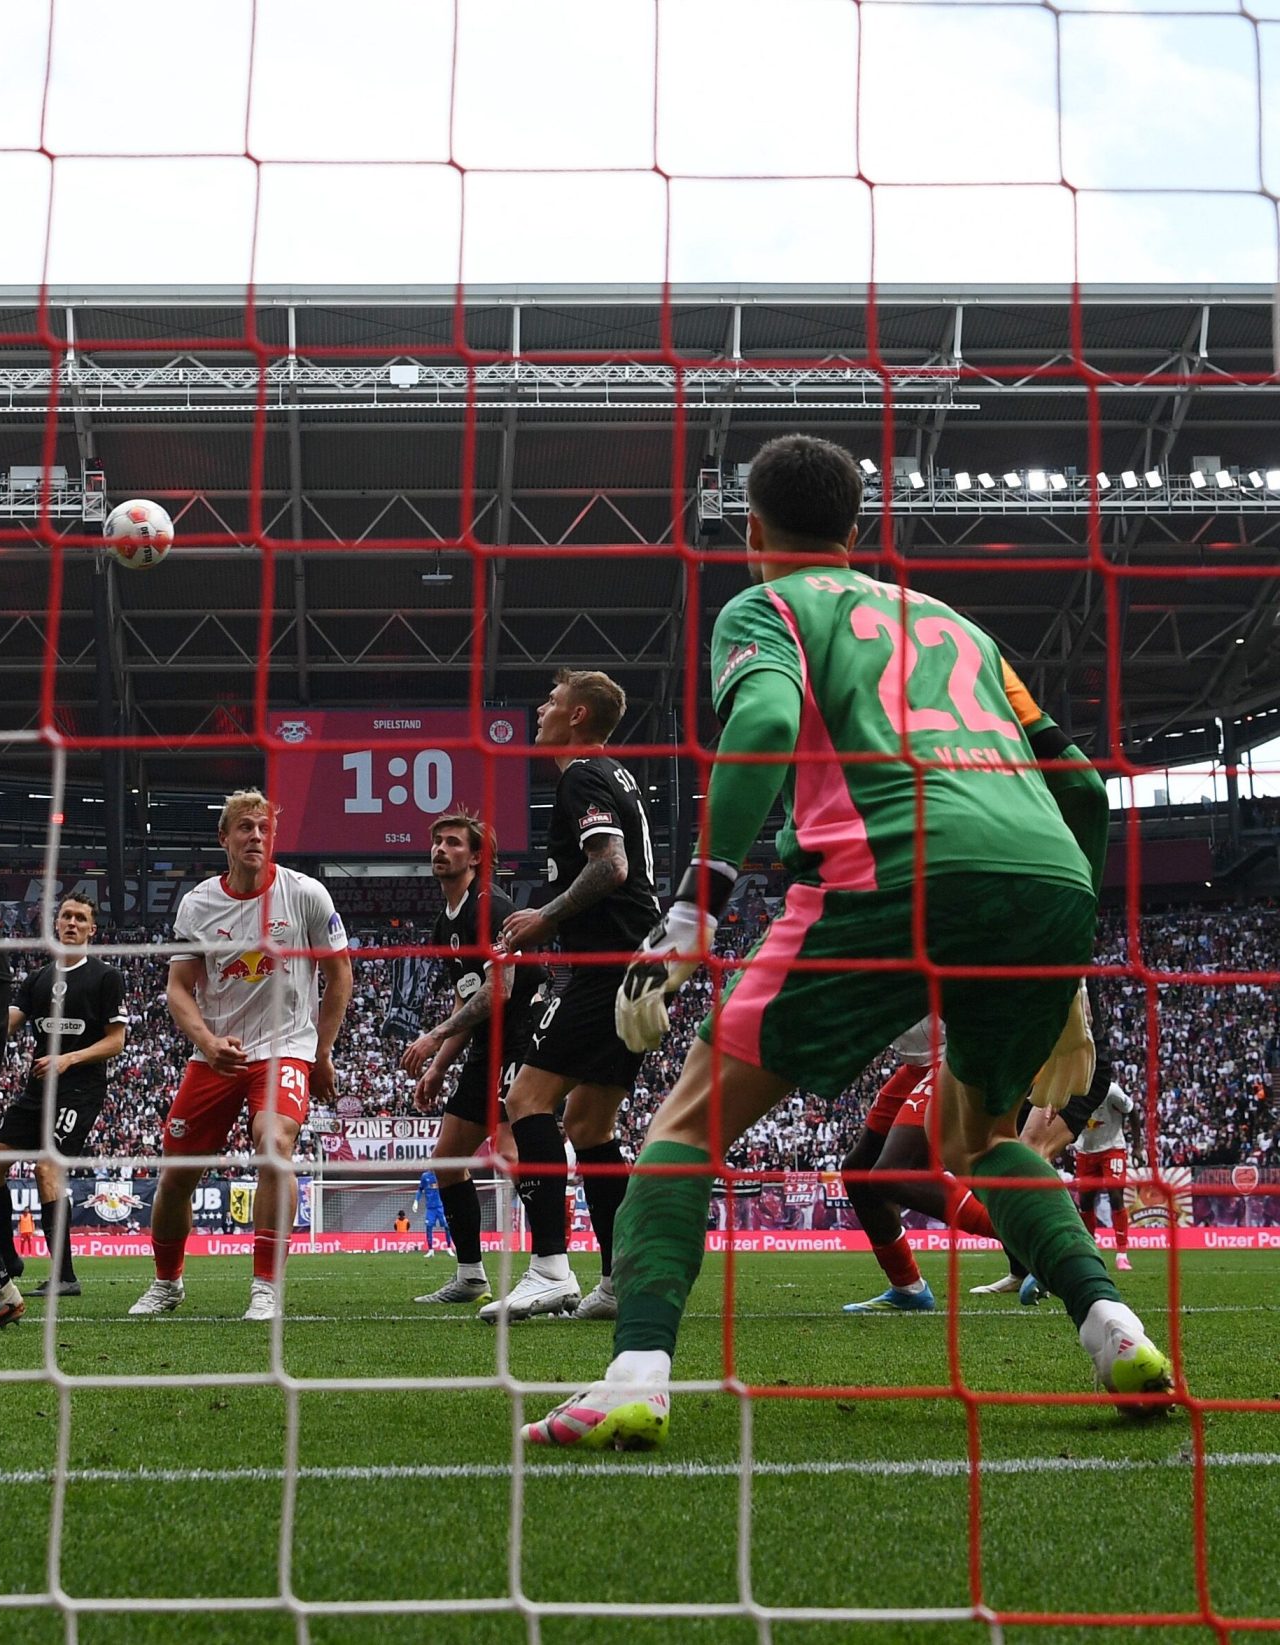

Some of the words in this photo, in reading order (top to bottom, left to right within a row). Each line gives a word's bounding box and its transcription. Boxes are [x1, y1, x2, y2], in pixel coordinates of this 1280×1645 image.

[850, 604, 1021, 741] 22
[373, 719, 422, 729] SPIELSTAND
[342, 749, 453, 814] 1:0
[581, 814, 609, 826] ASTRA
[384, 833, 411, 843] 53:54
[539, 997, 562, 1030] 8
[280, 1065, 306, 1097] 24
[55, 1107, 78, 1134] 19
[345, 1120, 392, 1139] ZONE
[413, 1119, 442, 1138] 147
[1109, 1157, 1125, 1173] 49
[519, 1178, 542, 1190] AULI
[796, 1183, 808, 1194] 29
[708, 1236, 757, 1251] Unzer
[763, 1235, 847, 1251] Payment.
[1204, 1232, 1255, 1248] Unzer
